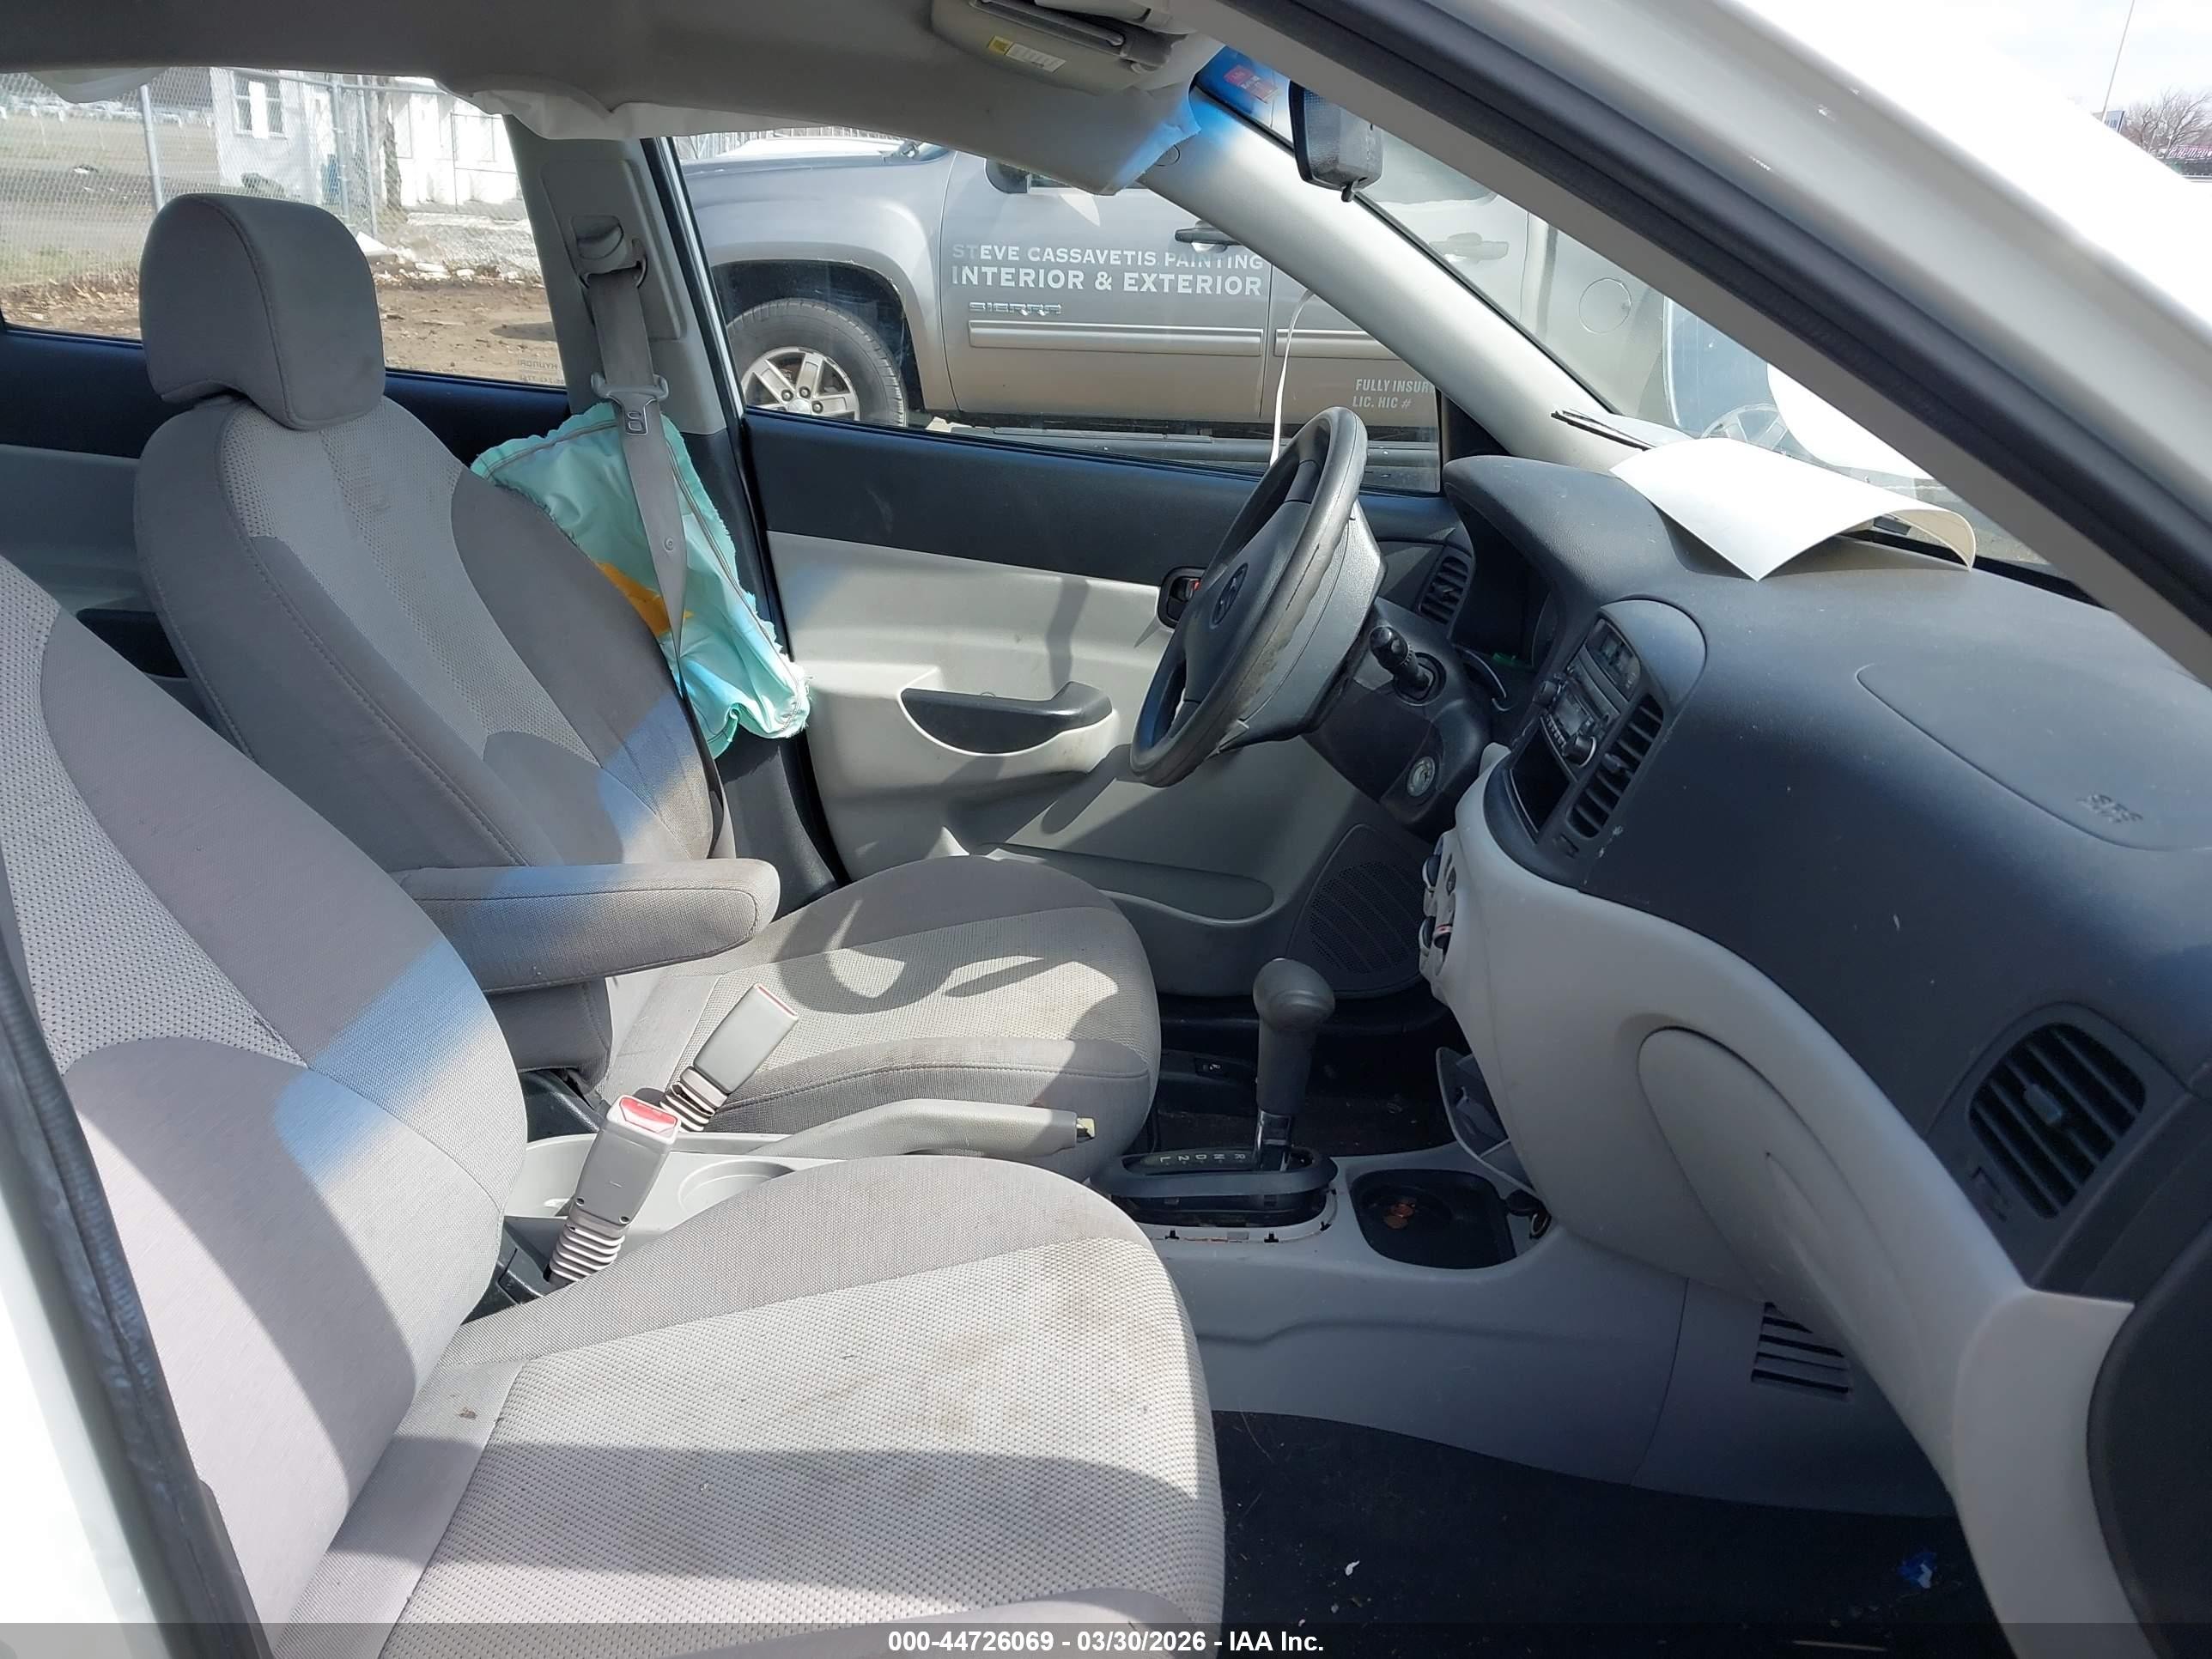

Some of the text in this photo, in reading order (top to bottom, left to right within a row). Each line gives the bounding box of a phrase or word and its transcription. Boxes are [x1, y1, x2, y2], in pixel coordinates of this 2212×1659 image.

[952, 244, 1263, 270] STEVE CASSAVETIS PAINTING
[951, 265, 1261, 295] INTERIOR & EXTERIOR
[969, 301, 1061, 316] SIERRA
[1355, 379, 1390, 392] FULLY
[1352, 395, 1374, 408] LIC.
